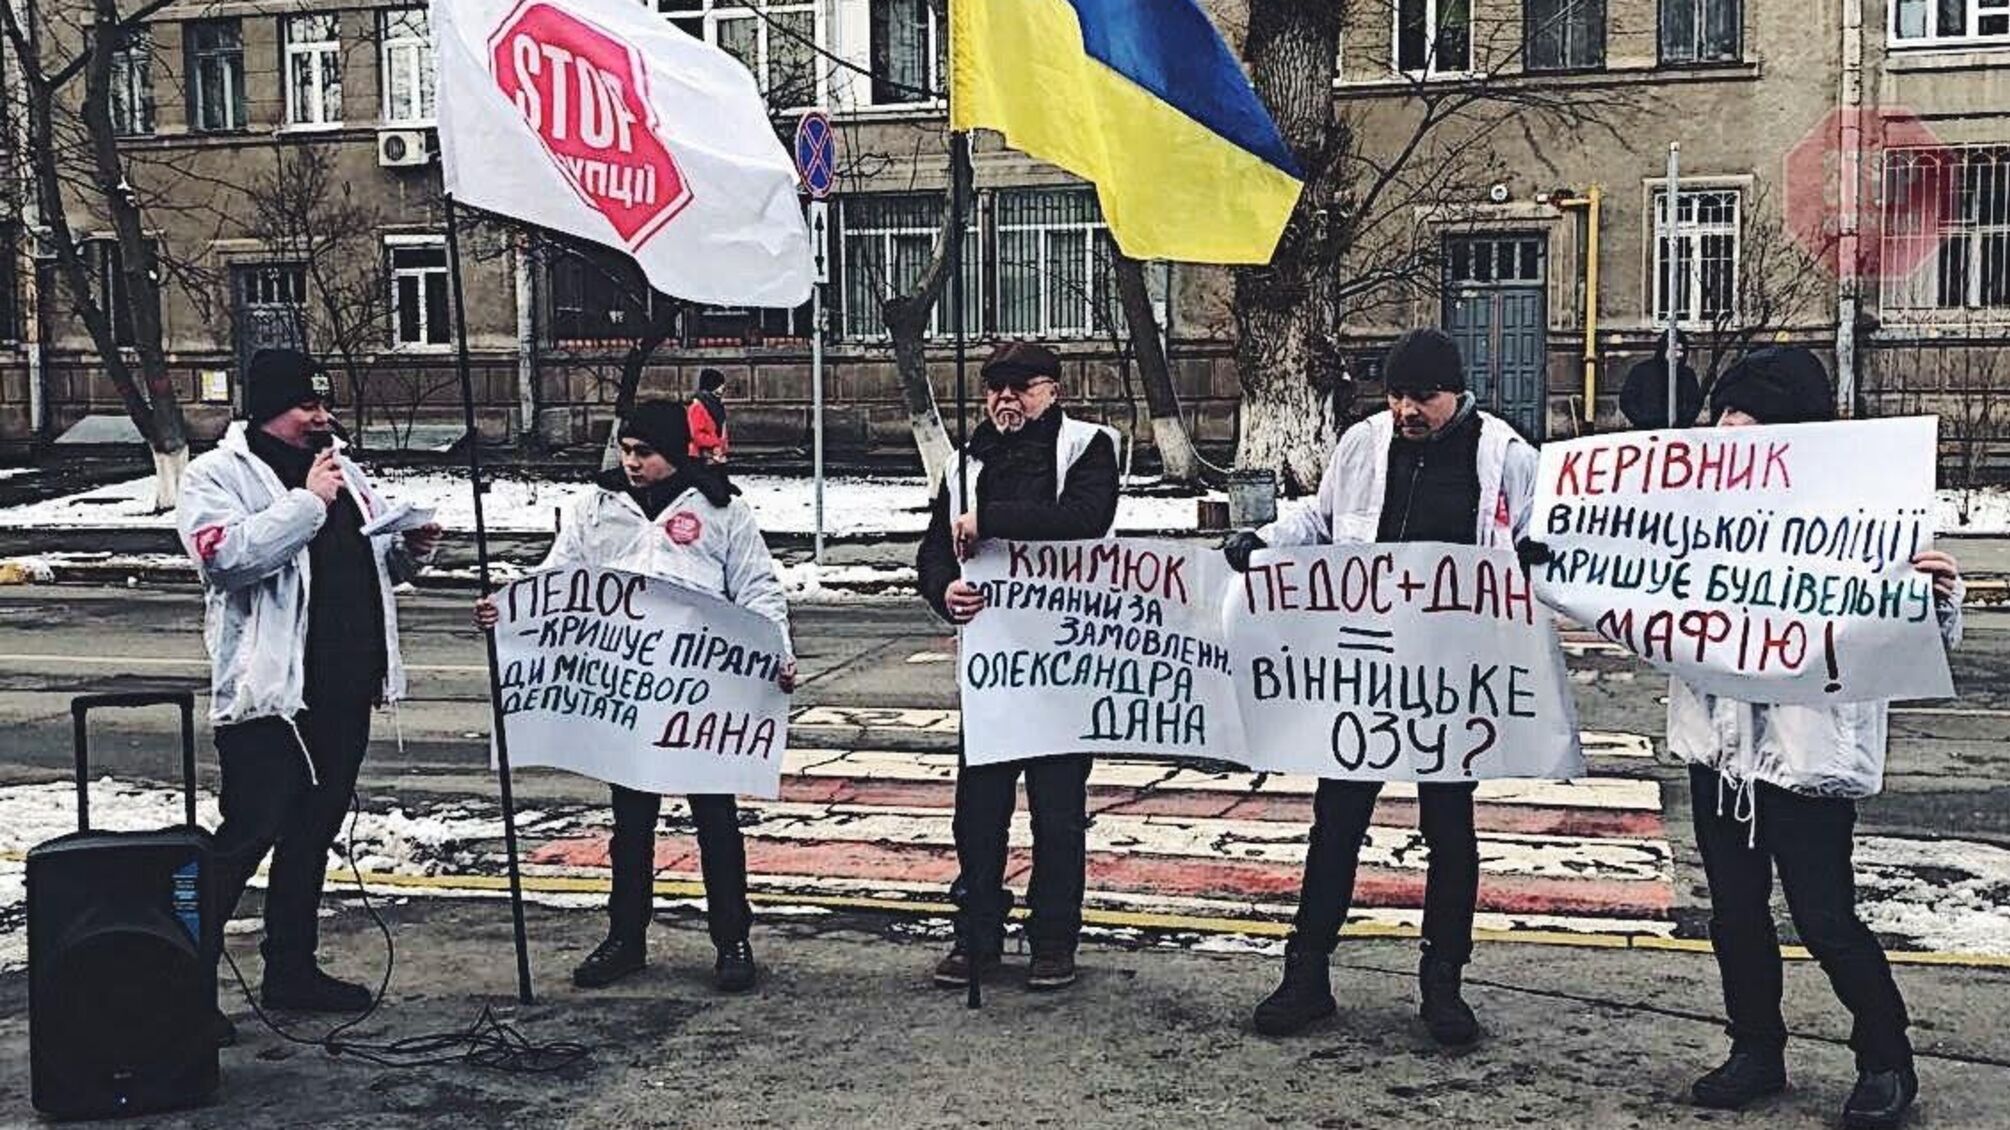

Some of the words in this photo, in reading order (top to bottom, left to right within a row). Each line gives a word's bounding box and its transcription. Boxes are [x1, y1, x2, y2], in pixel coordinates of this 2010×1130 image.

[1556, 435, 1791, 496] КЕРІВНИК
[1547, 497, 1774, 559] ВІННИЦЬКОЇ
[1781, 508, 1927, 574] ПОЛІЦІЇ
[508, 568, 647, 623] ПЕДОС
[1008, 542, 1187, 603] КЛИМЮК
[1546, 548, 1691, 600] КРИШУЄ
[1706, 563, 1929, 623] БУДІВЕЛЬНУ
[1128, 594, 1163, 626] ЗА
[1054, 617, 1232, 676] ЗАМОВЛЕНН.
[500, 655, 545, 689] ДИ
[551, 651, 710, 705] МІСЦЕВОГО
[967, 650, 1193, 703] ОЛЕКСАНДРА
[1252, 645, 1536, 718] ВІННИЦЬКЕ
[502, 685, 639, 731] ДЕПУТАТА
[652, 711, 776, 759] ДАНА
[1078, 695, 1205, 745] ДАНА
